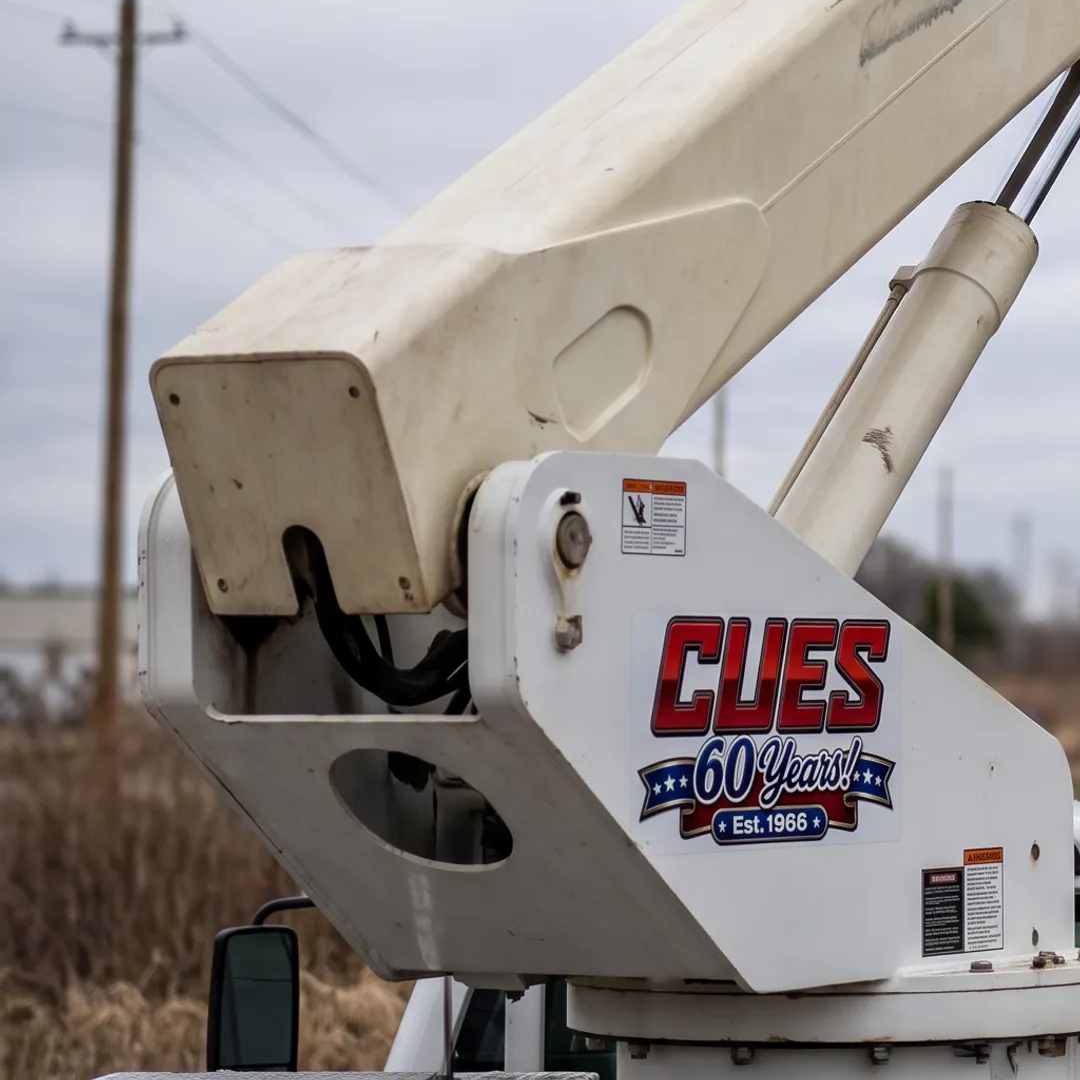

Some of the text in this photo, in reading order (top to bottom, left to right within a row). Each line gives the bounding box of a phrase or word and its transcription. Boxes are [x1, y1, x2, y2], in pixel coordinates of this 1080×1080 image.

[650, 615, 891, 737] CUES
[693, 734, 863, 810] 60 Years!
[732, 812, 808, 835] Est. 1966
